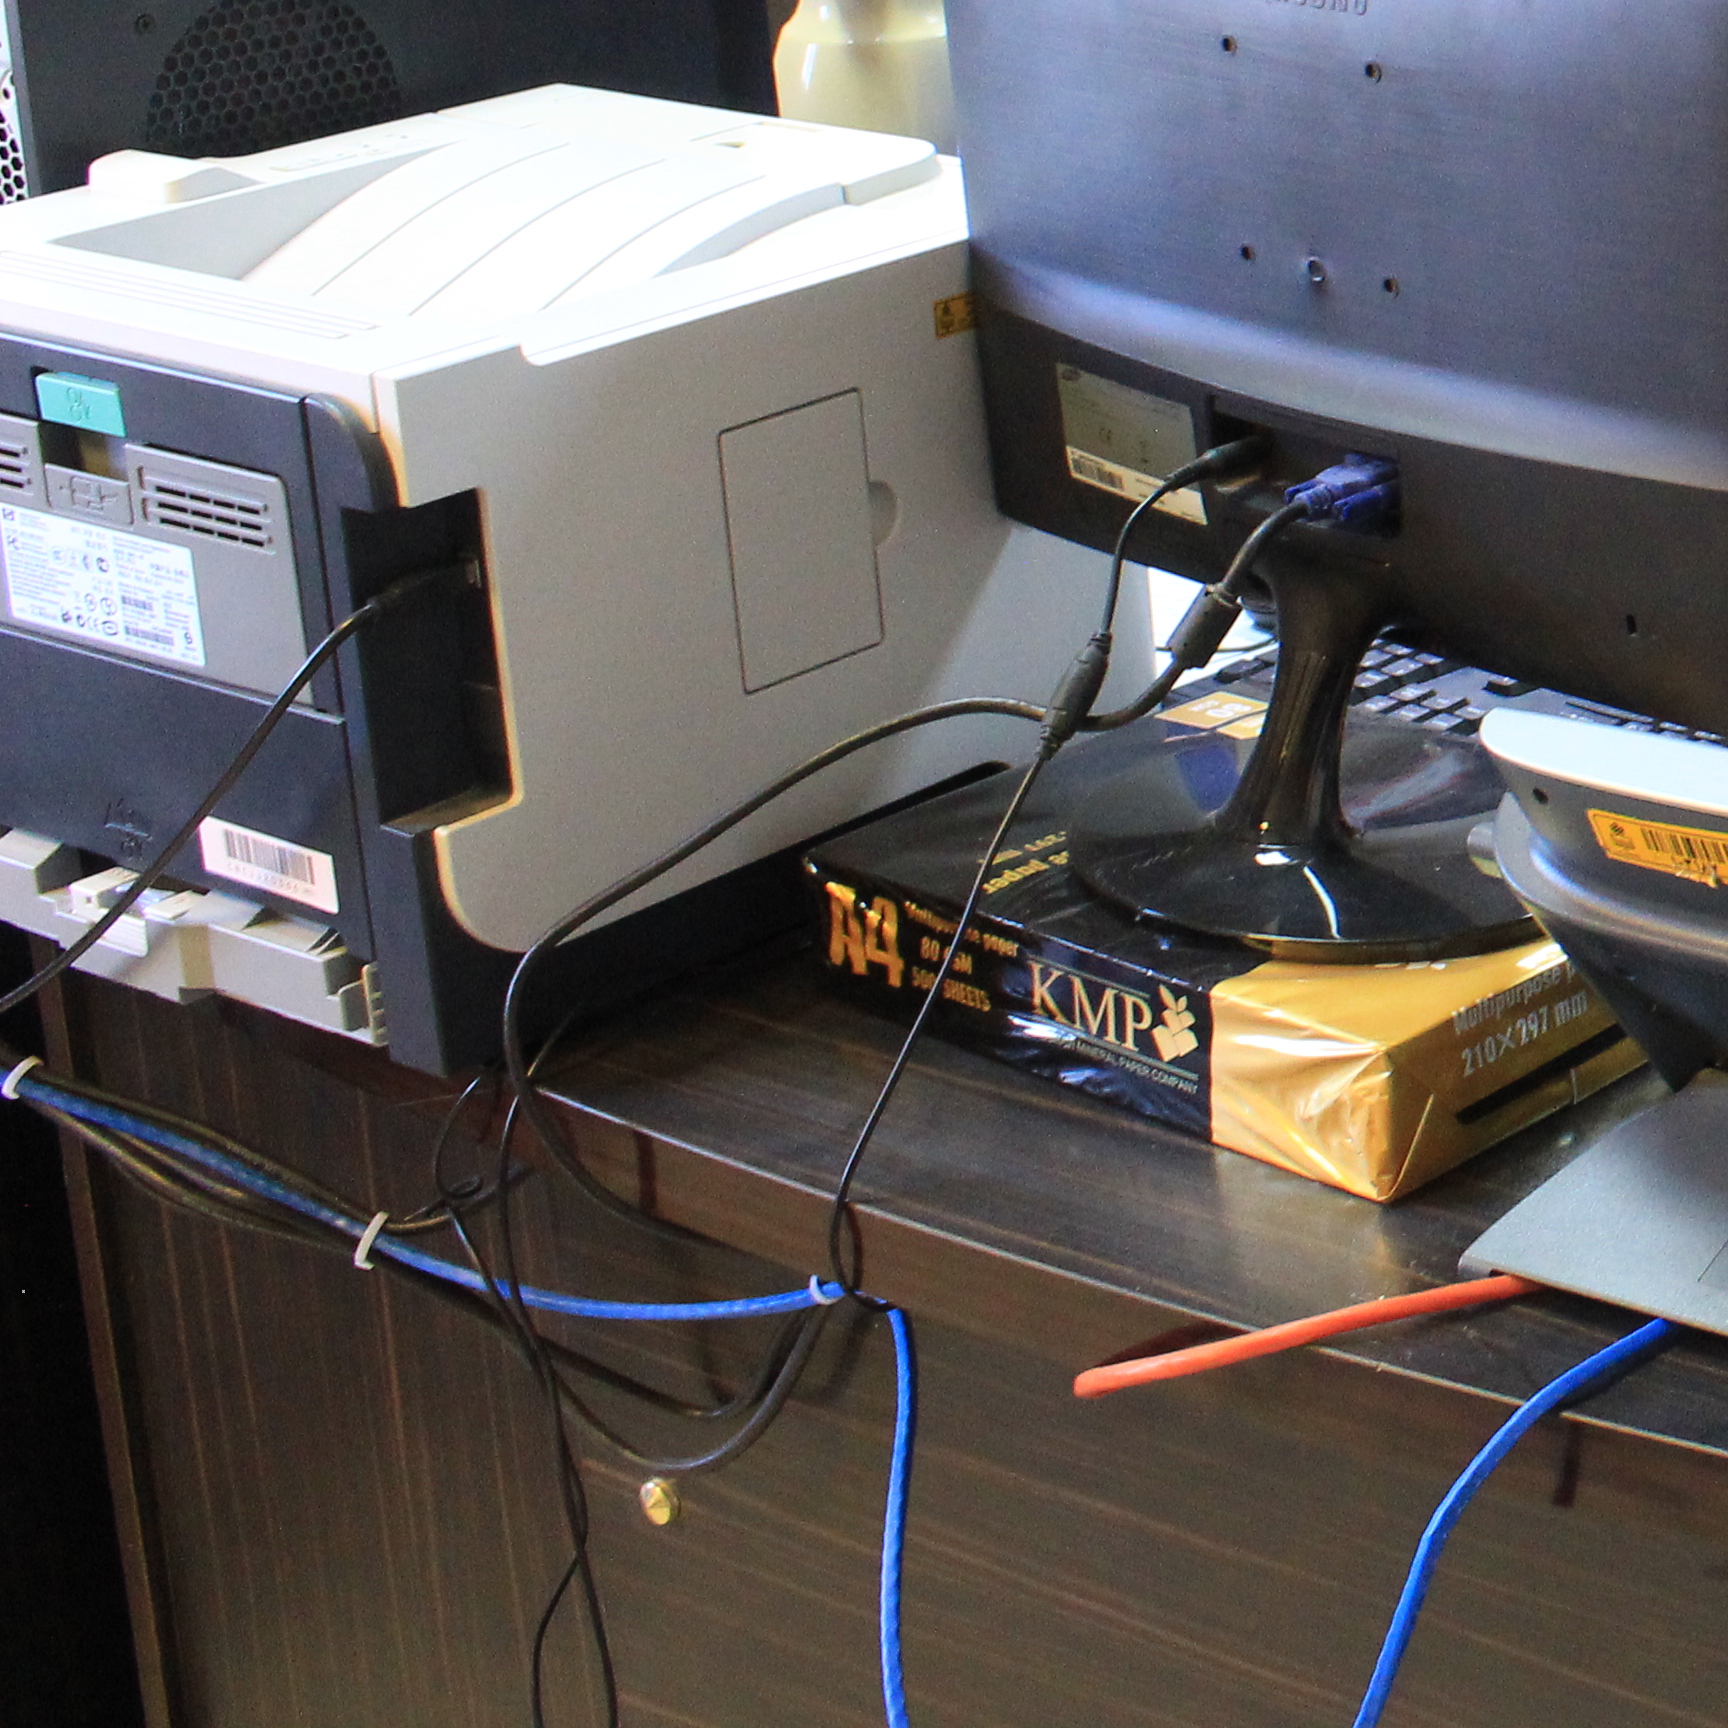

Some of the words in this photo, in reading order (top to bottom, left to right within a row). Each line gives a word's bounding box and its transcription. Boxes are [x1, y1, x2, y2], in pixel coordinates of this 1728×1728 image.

[824, 881, 905, 988] A4
[920, 936, 940, 962] 80
[1027, 960, 1153, 1052] KMP
[1151, 1068, 1199, 1096] COMPANY
